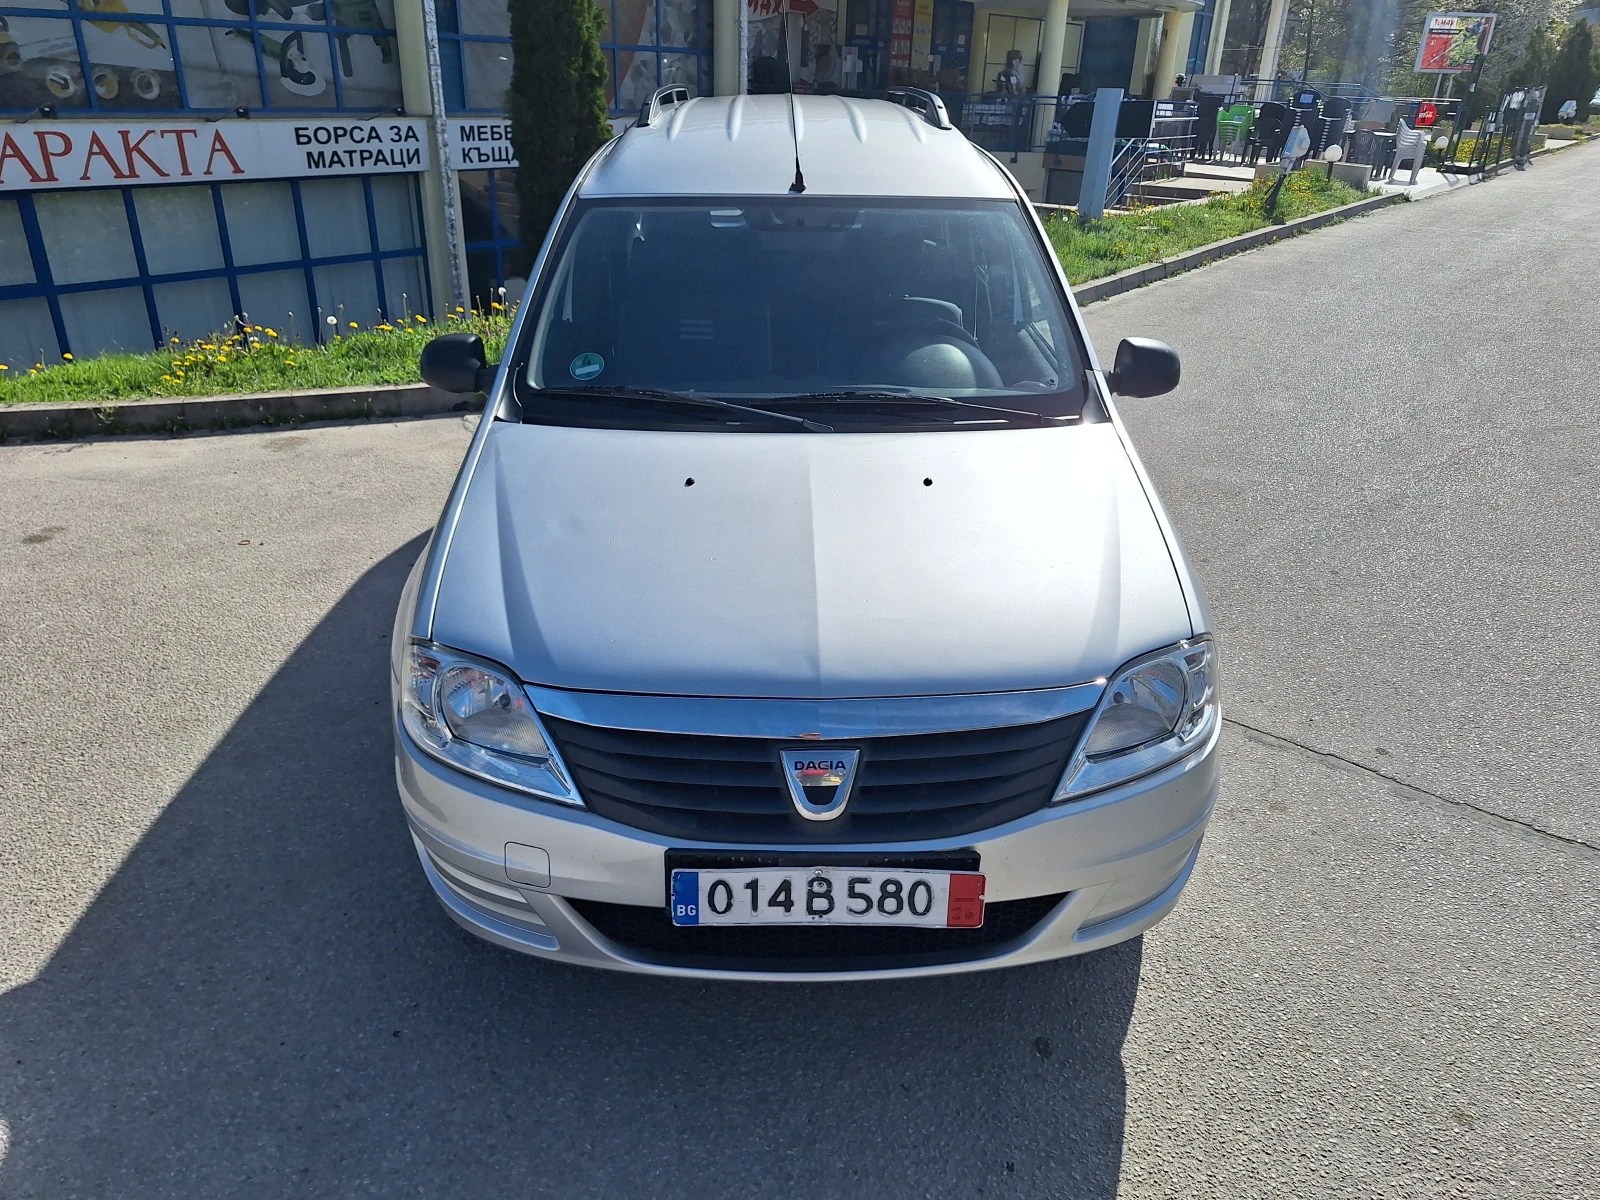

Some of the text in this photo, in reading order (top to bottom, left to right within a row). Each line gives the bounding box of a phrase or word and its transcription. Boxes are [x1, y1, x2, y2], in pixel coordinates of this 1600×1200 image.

[294, 125, 420, 146] БОРСА ЗА
[0, 128, 245, 184] АРАКТА
[306, 148, 421, 170] МАТРАЦИ
[461, 146, 516, 165] КЪЩ
[794, 760, 846, 770] DACIA
[676, 904, 697, 917] BG
